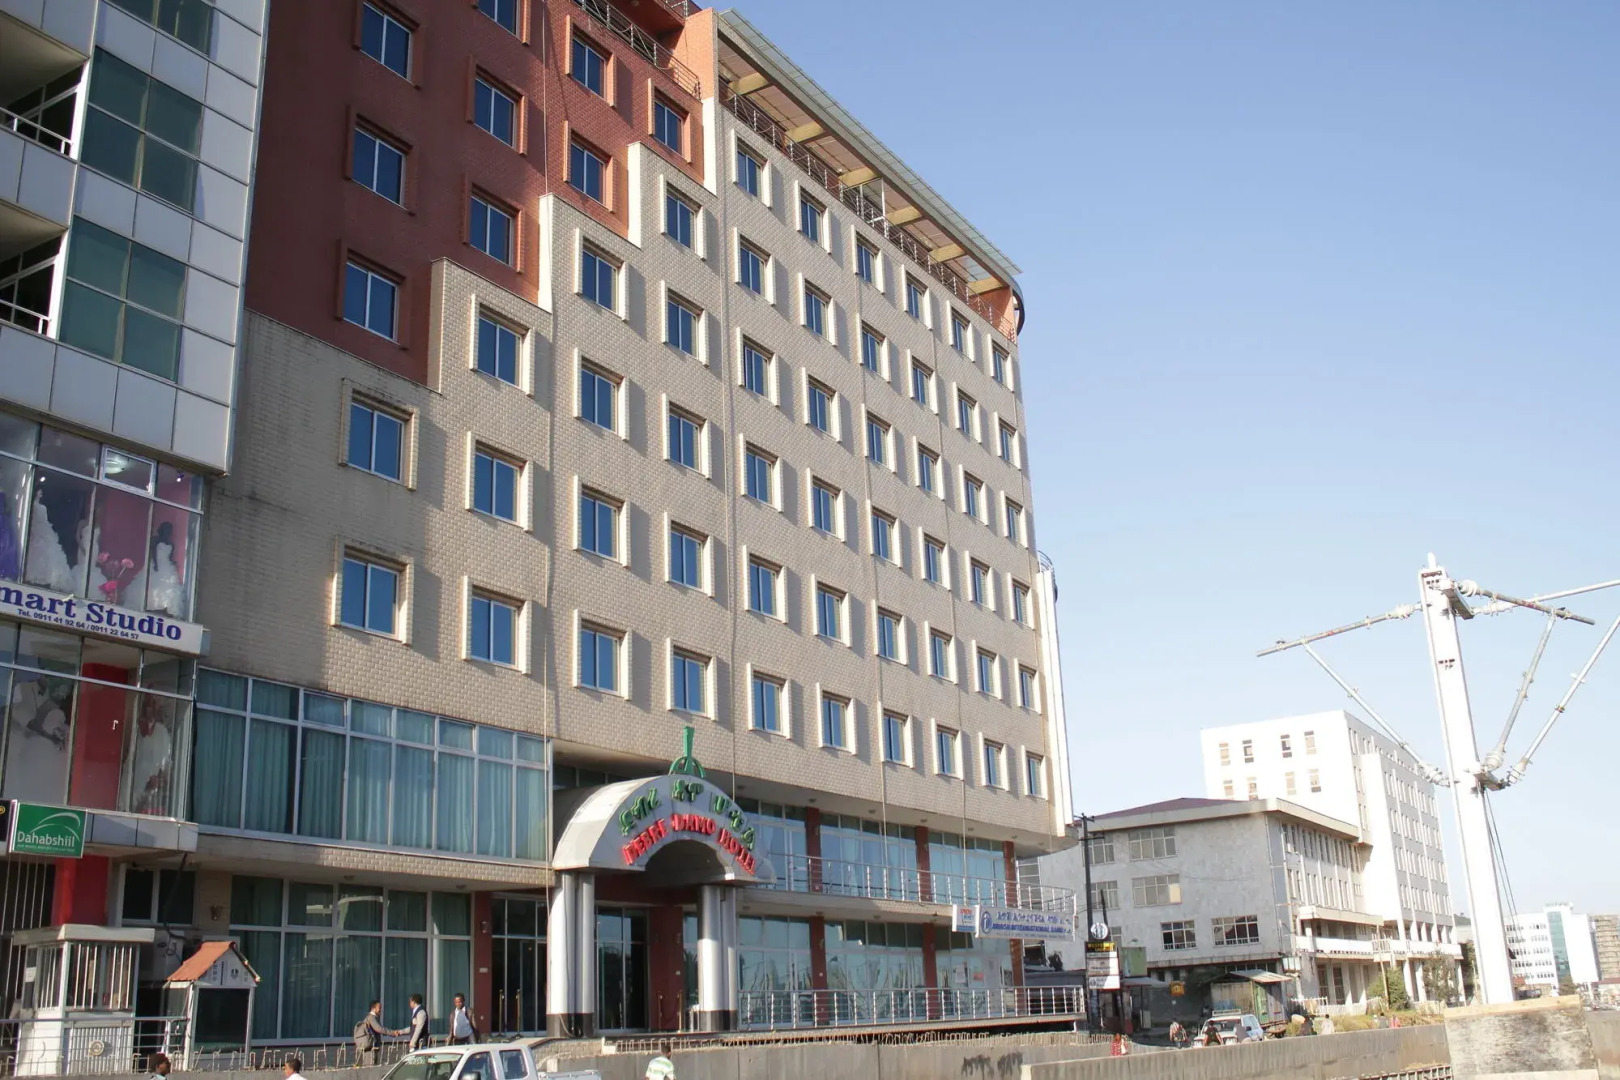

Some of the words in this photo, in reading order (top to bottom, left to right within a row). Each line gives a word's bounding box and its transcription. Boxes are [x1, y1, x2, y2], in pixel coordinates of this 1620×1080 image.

[17, 609, 31, 617] Tel.
[33, 612, 52, 621] 0911
[91, 624, 108, 633] 0911
[110, 628, 119, 636] 22
[86, 602, 182, 640] Studio
[17, 831, 75, 848] Dahabshiil
[622, 818, 669, 865] DEBRE
[671, 813, 716, 835] DAMO
[717, 827, 756, 875] HOTEL
